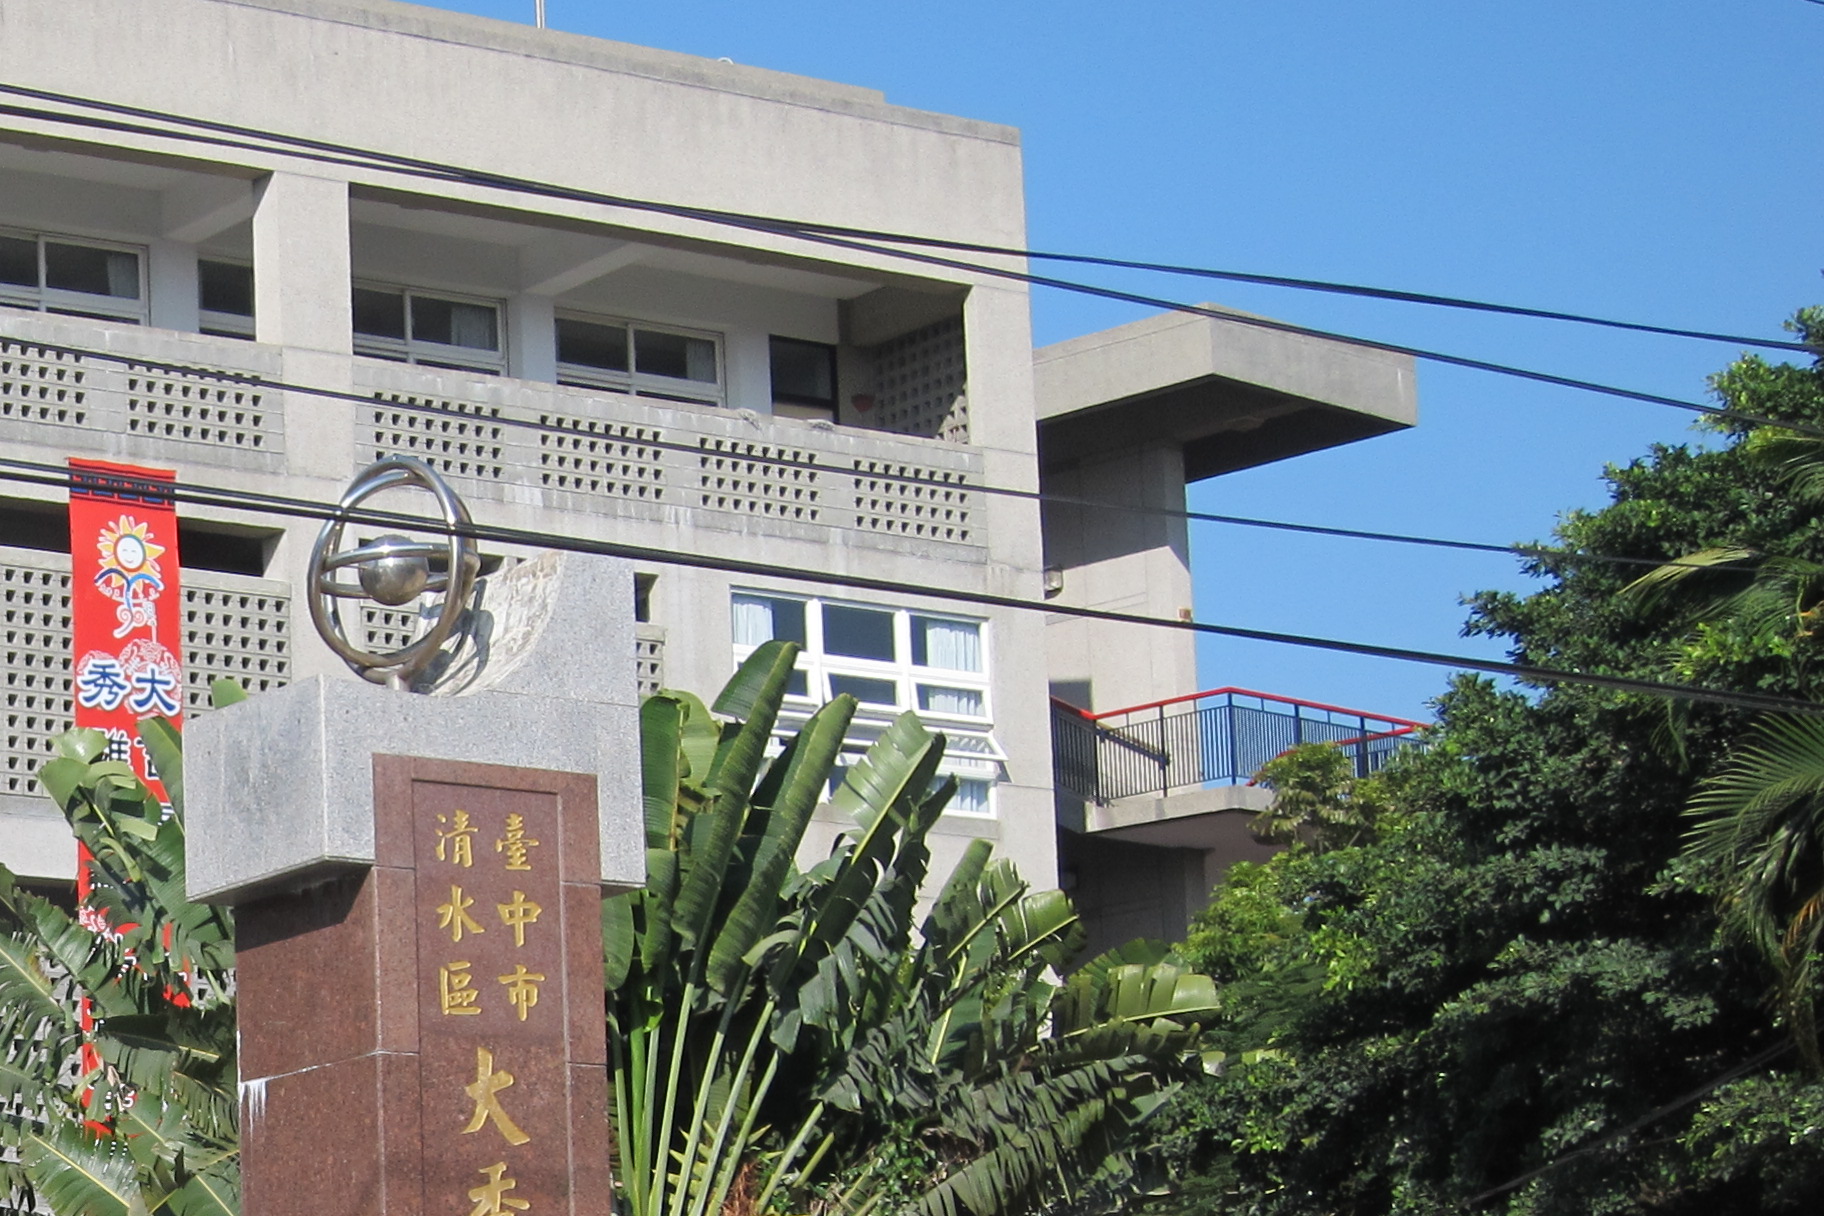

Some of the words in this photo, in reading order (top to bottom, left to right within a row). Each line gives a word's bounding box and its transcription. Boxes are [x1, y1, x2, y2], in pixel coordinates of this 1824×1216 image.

[434, 808, 486, 1017] 清水區
[494, 812, 547, 1022] 臺中市
